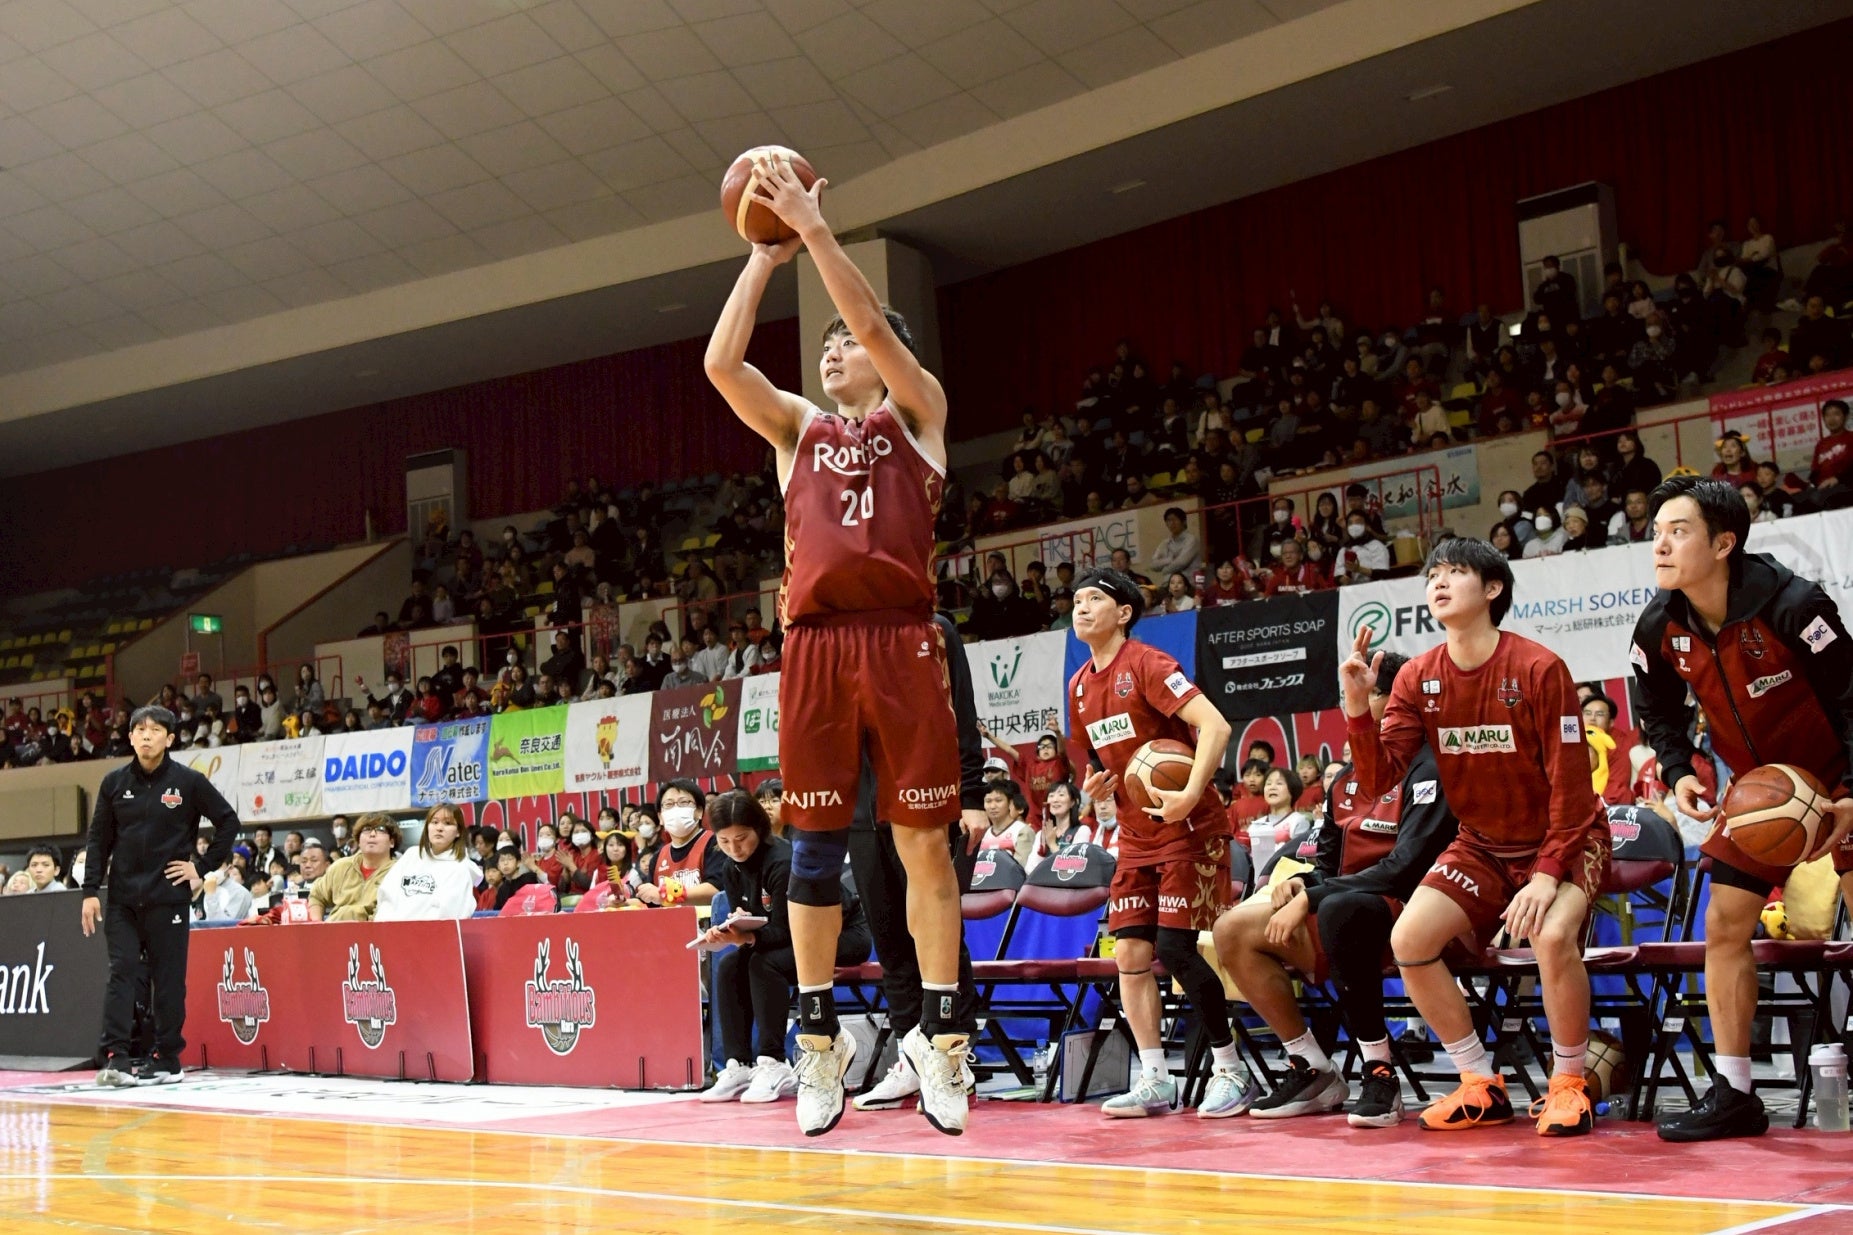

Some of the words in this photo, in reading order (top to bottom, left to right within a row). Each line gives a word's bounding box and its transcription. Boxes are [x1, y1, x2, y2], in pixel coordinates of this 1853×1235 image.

[840, 485, 874, 526] 20
[1513, 597, 1582, 620] MARSH
[1589, 586, 1659, 611] SOKEN
[1395, 603, 1447, 637] FR
[1534, 613, 1636, 634] マーシュ総研株式会社
[1208, 630, 1245, 644] AFTER
[1246, 623, 1291, 641] SPORTS
[1293, 619, 1325, 635] SOAP
[1758, 671, 1790, 687] MARU
[663, 705, 696, 721] 医療法人
[977, 706, 1058, 737] 中央病院
[520, 734, 562, 754] 奈良交通
[1465, 729, 1509, 743] MARU
[325, 750, 406, 783] DAIDO
[416, 746, 481, 787] Natec
[417, 784, 480, 802] ナテック株式会社
[898, 784, 957, 803] KOHWA
[1109, 895, 1150, 914] AJITA
[1158, 894, 1188, 909] HWA
[527, 983, 593, 1025] Bambitious
